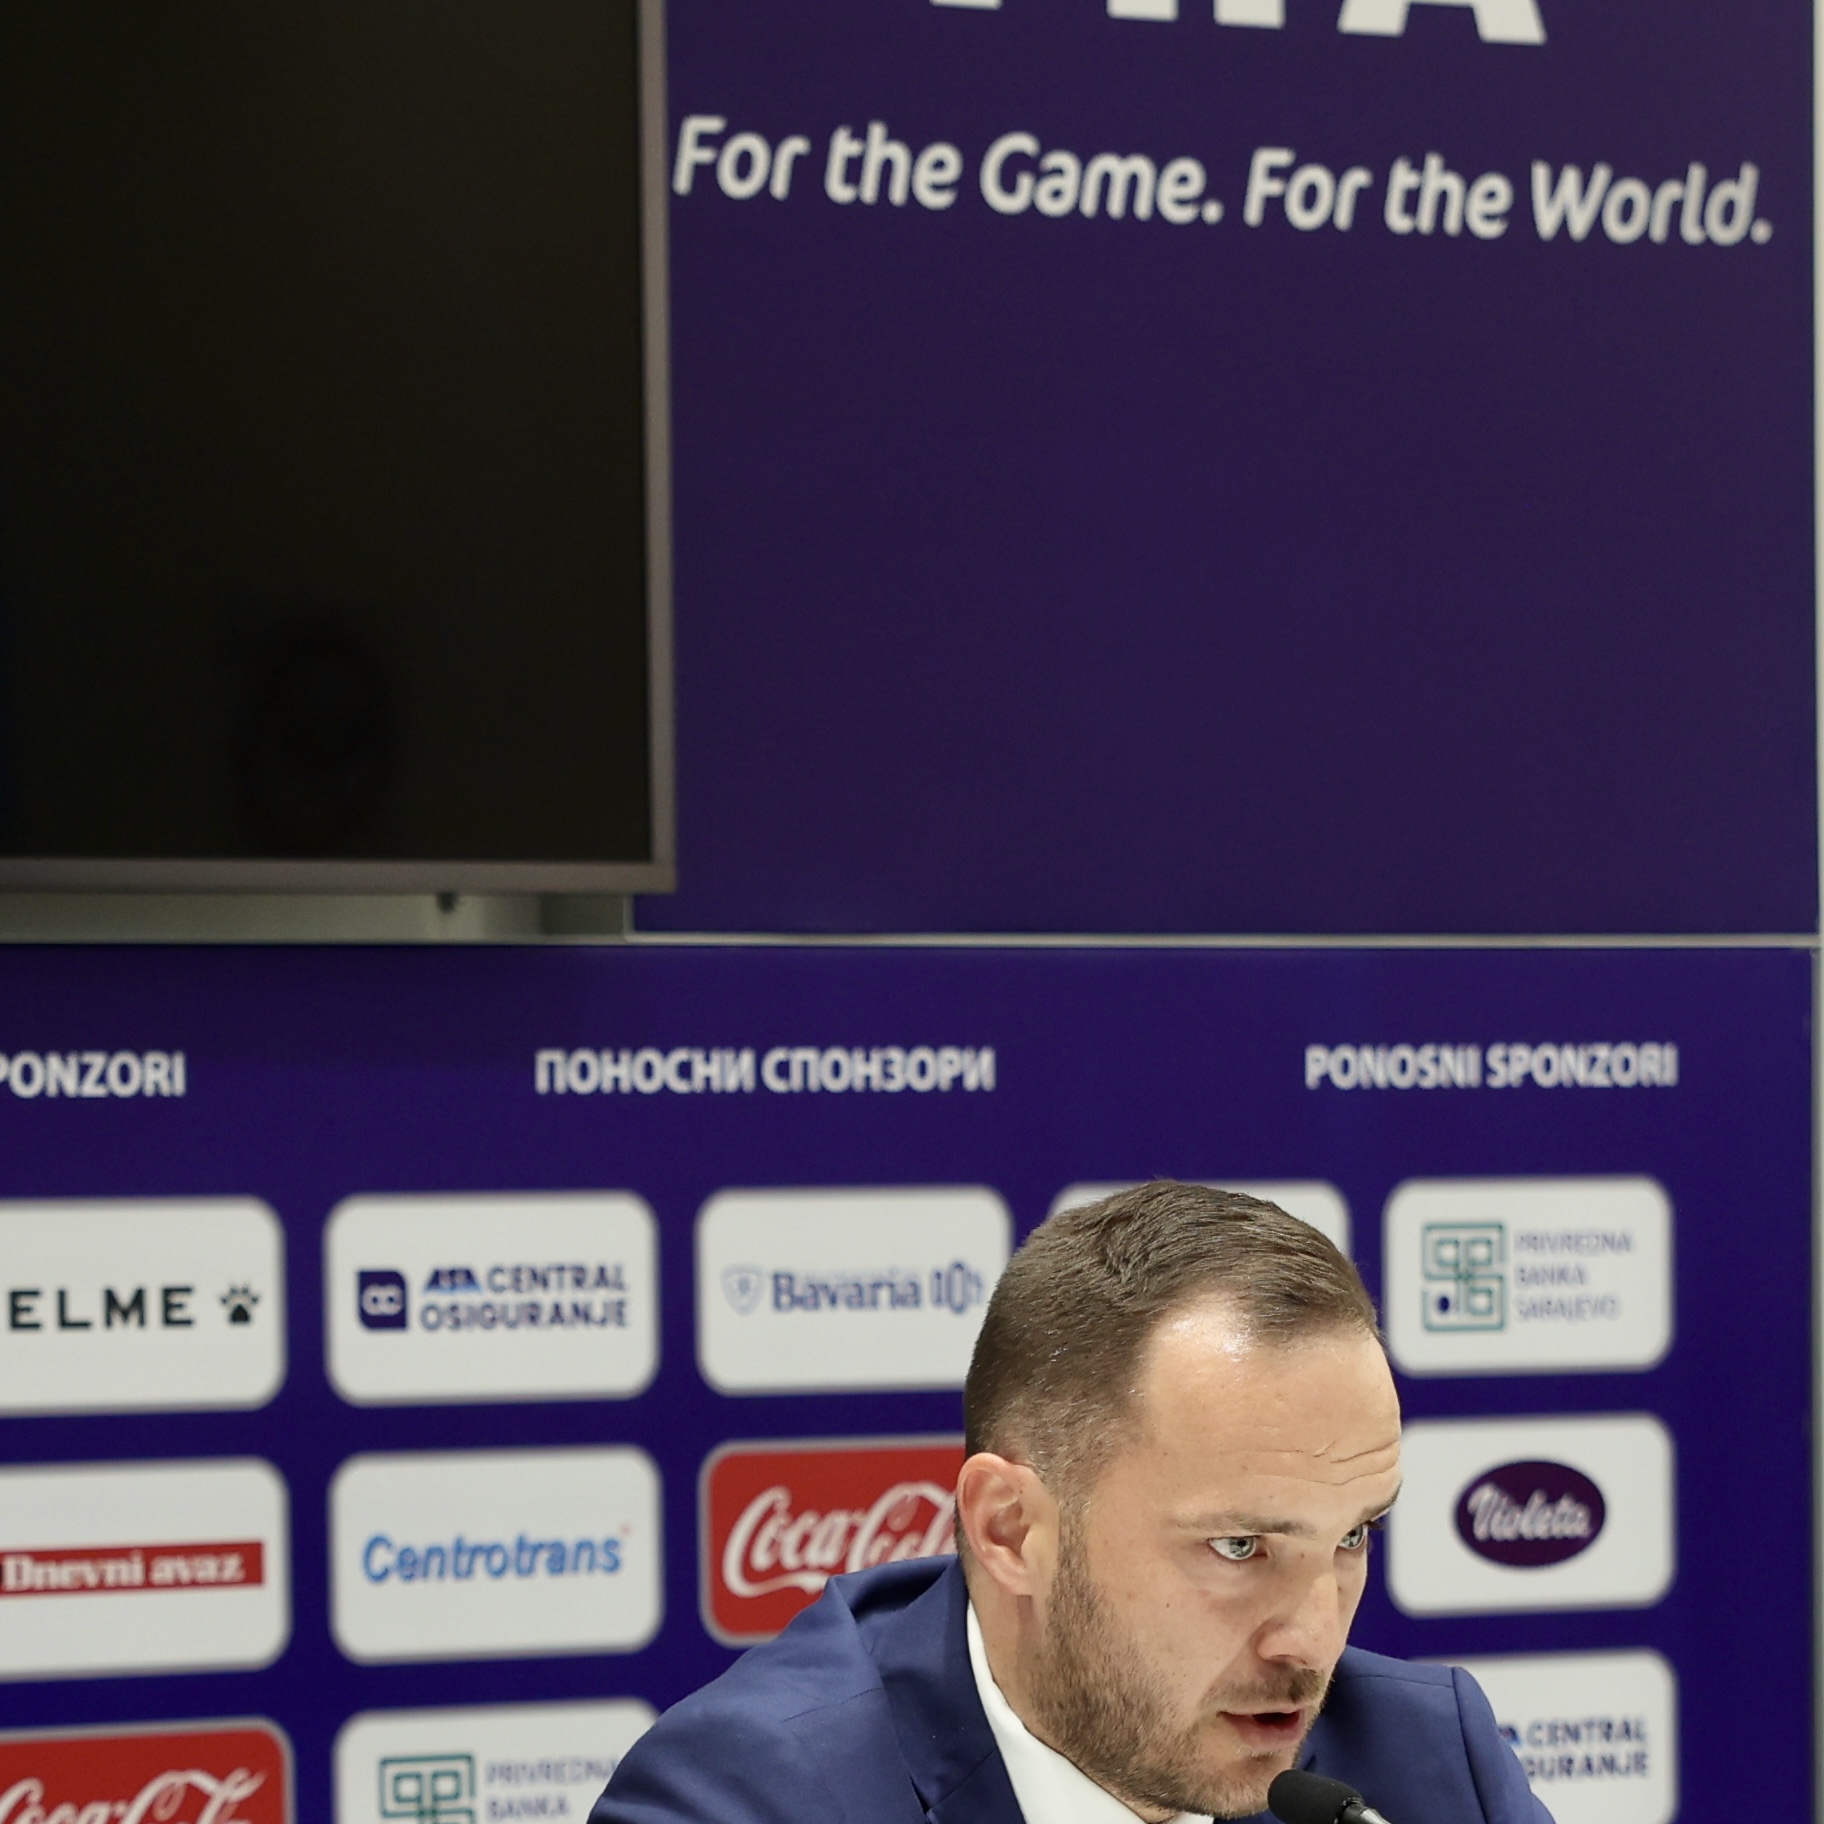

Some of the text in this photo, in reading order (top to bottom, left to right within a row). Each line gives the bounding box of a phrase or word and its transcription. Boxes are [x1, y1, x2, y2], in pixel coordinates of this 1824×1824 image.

[673, 115, 1774, 246] For the Game. For the World.
[535, 1047, 995, 1095] ПОНОСНИ СПОНЗОРИ
[1305, 1043, 1678, 1090] PONOSNI SPONZORI
[487, 1264, 627, 1292] CENTRAL
[773, 1265, 922, 1313] Bavaria
[421, 1299, 628, 1331] OSIGURANJE
[1467, 1483, 1592, 1541] Violeta
[2, 1550, 245, 1592] Dnevni avaz
[362, 1534, 622, 1584] Centrotrans
[1527, 1717, 1645, 1747] CENTRAL
